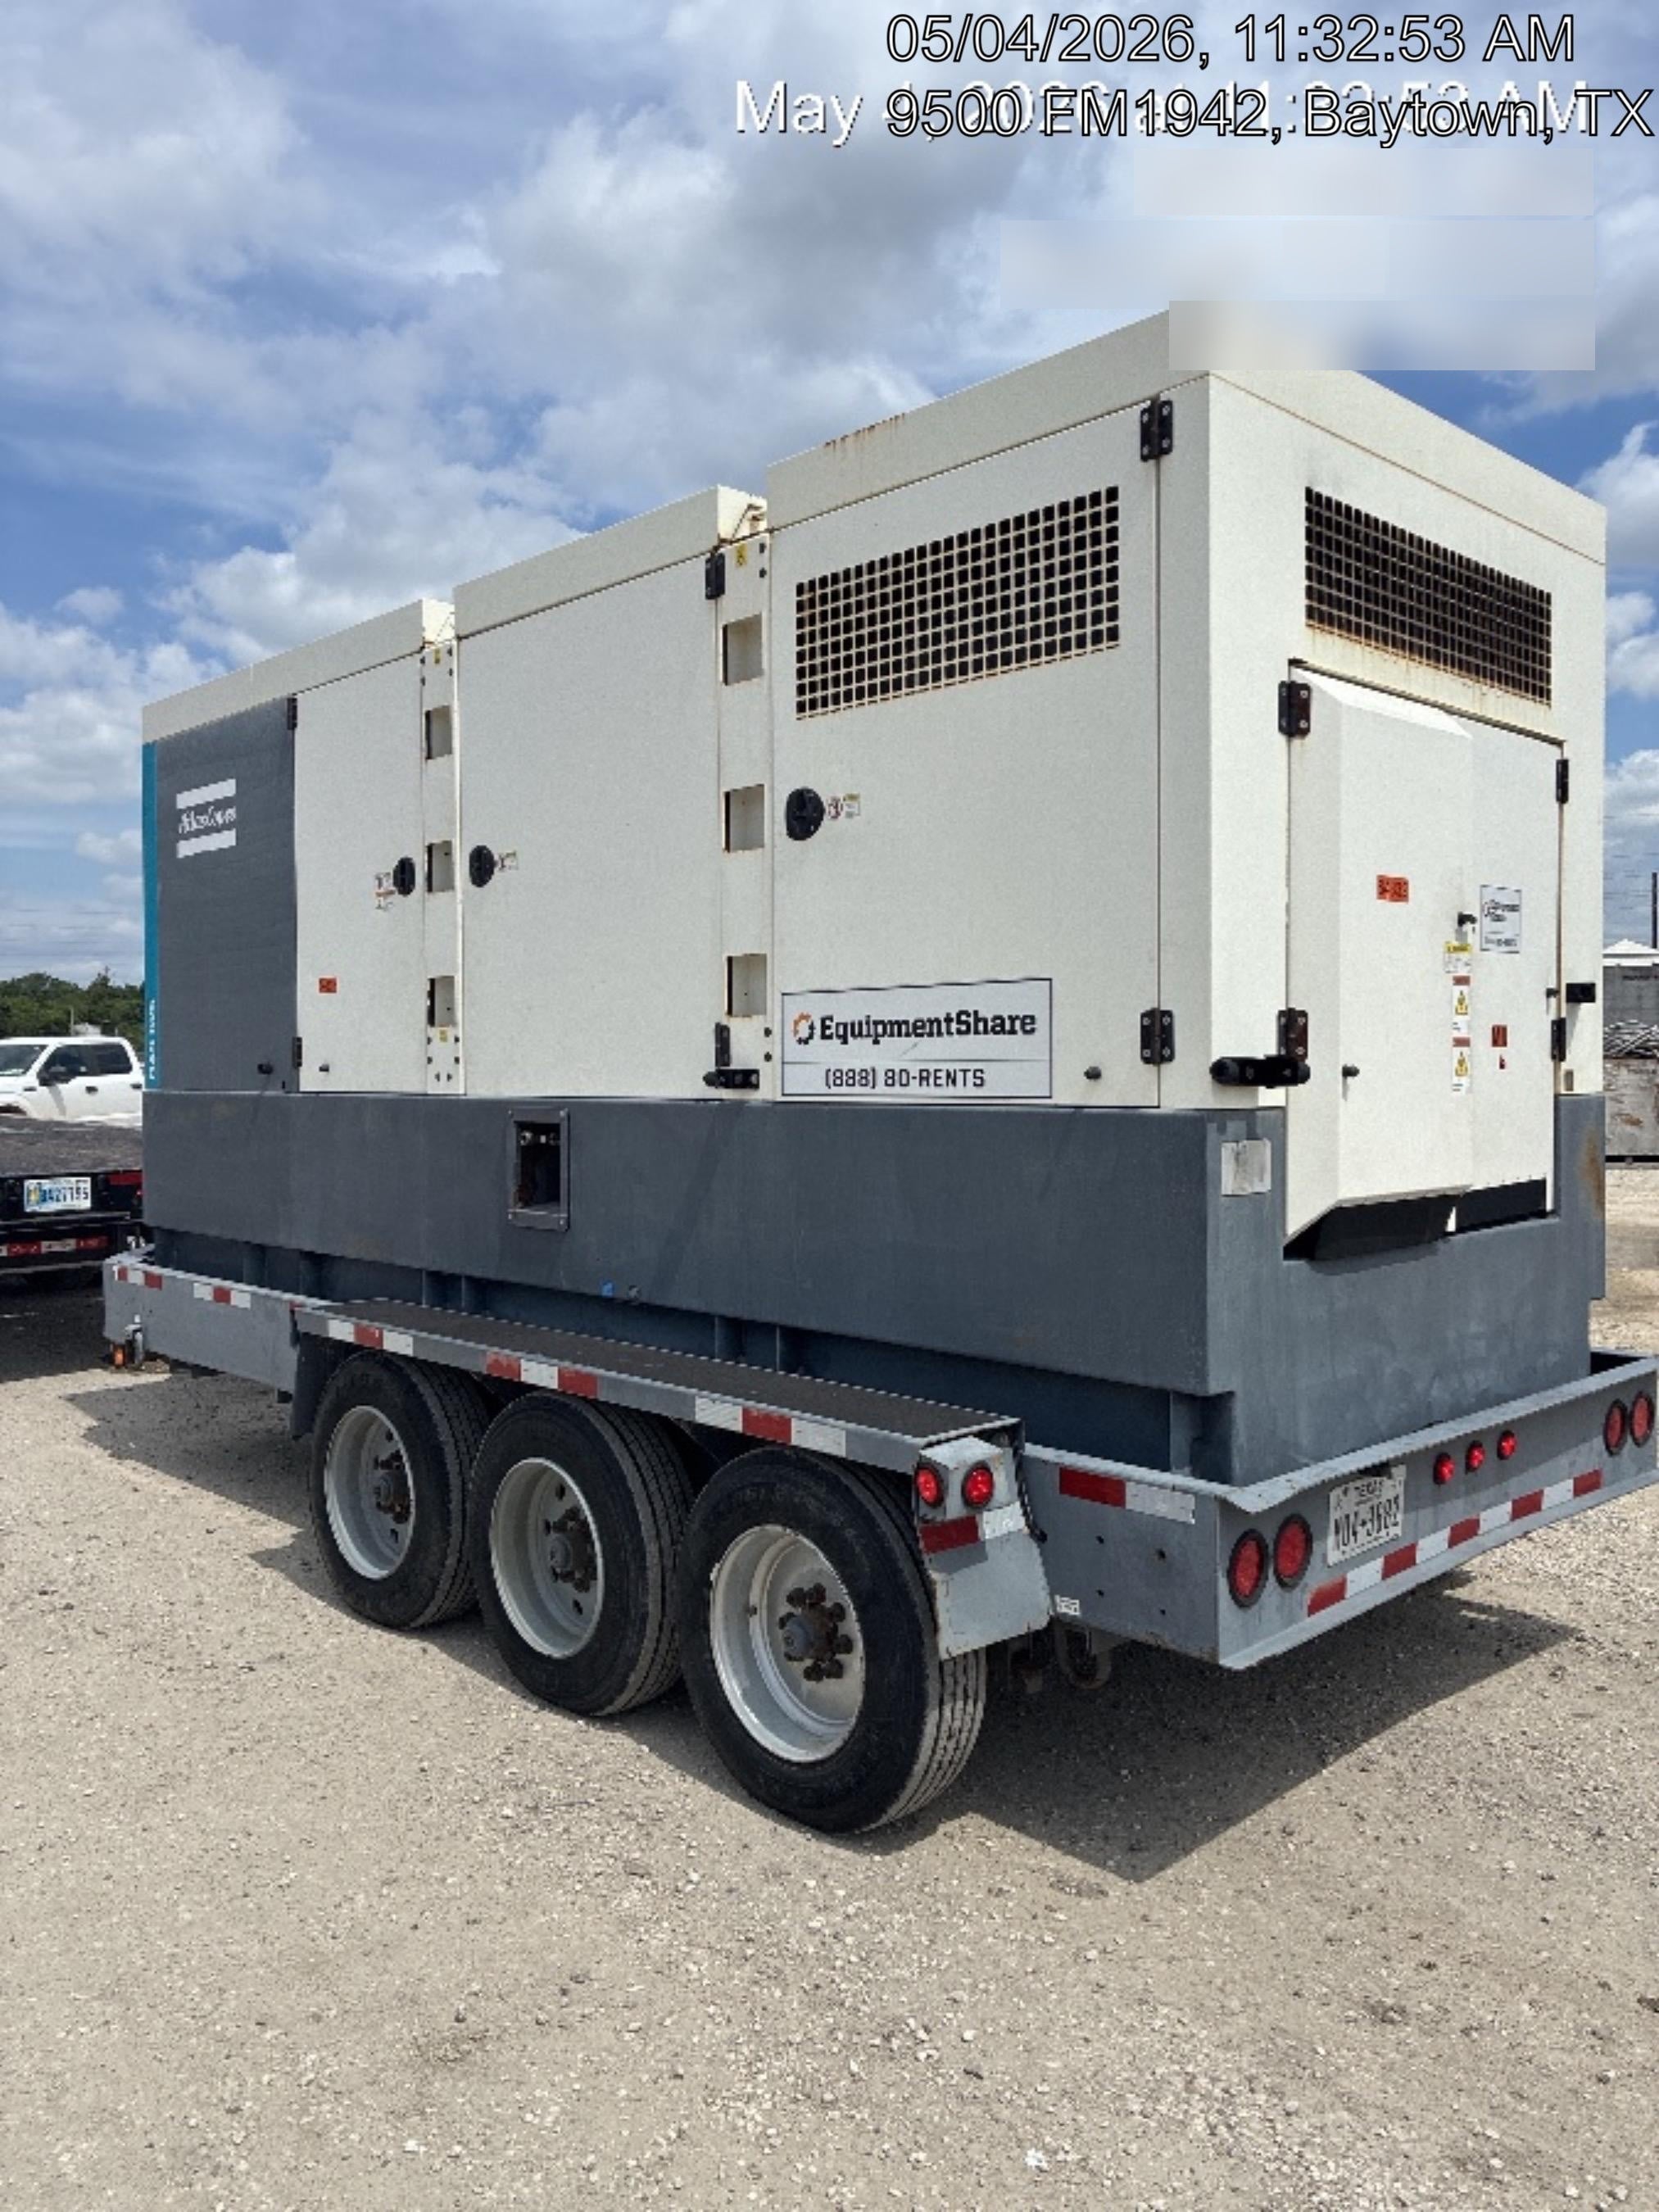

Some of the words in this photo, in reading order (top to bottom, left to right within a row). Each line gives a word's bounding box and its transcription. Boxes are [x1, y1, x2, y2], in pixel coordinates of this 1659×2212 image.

[819, 1009, 1036, 1045] EquipmentShare
[825, 1067, 877, 1090] (888)
[884, 1068, 985, 1089] 80-RENTS
